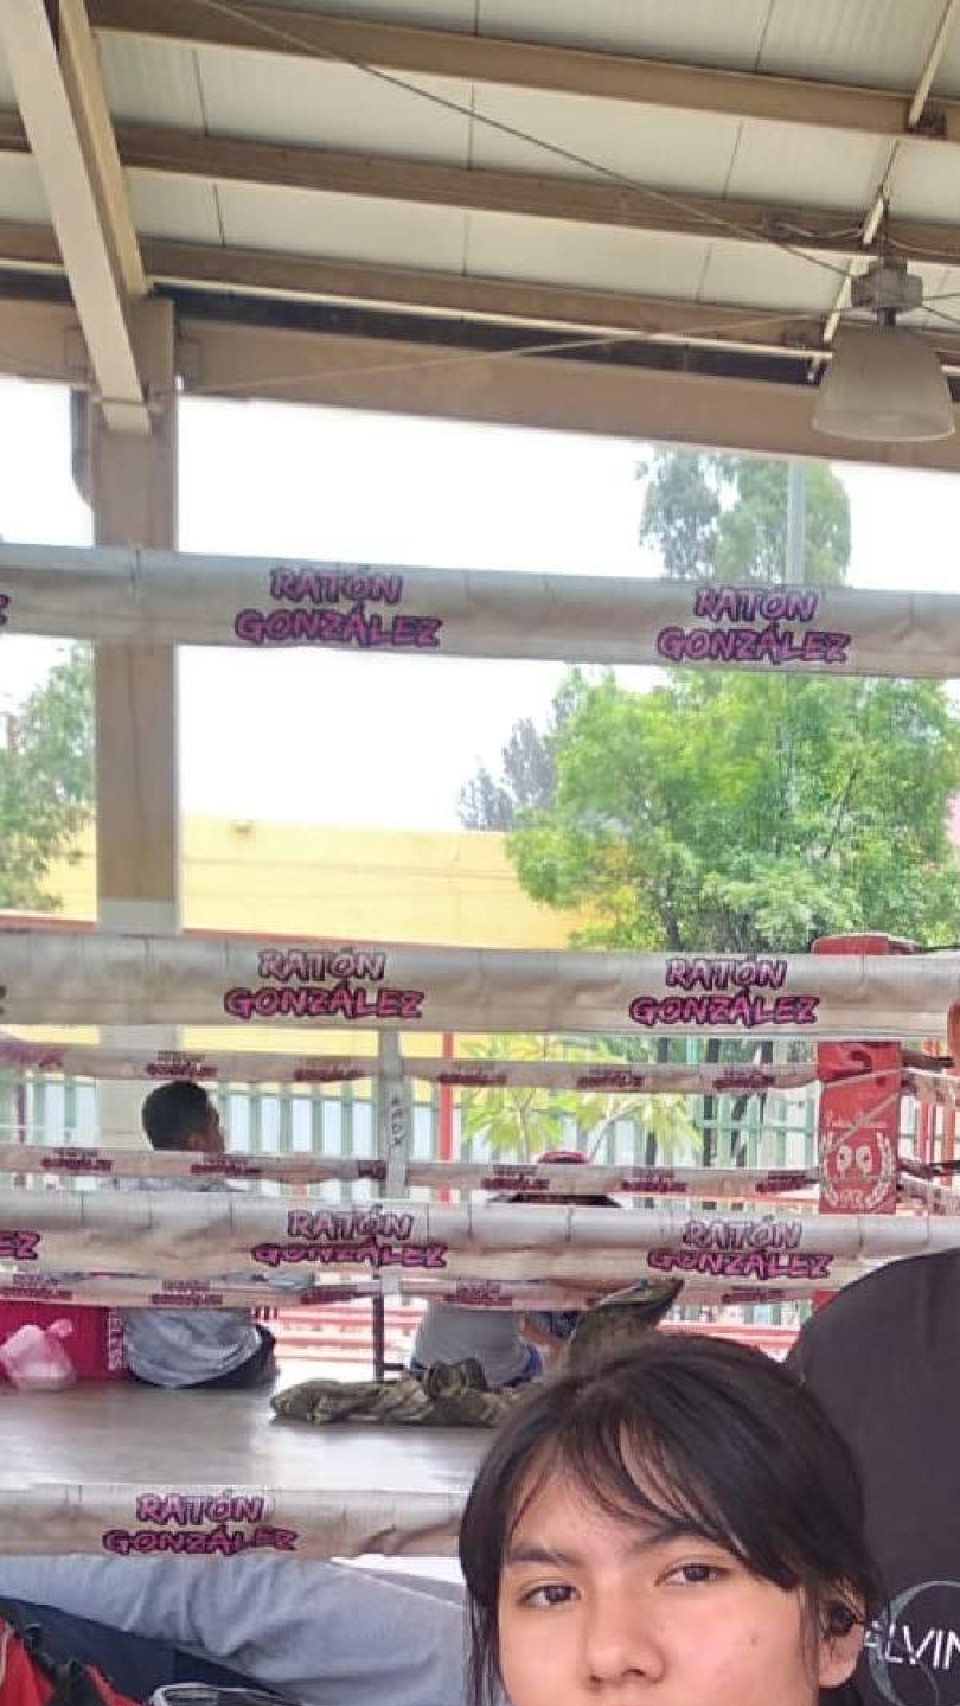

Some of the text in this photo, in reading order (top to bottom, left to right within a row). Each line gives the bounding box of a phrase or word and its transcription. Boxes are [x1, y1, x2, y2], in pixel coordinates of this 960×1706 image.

[234, 603, 442, 648] GONZÁLEZ
[656, 623, 851, 665] GONZÁLEZ
[224, 979, 425, 1019] GONZÁLEZ
[630, 986, 820, 1027] GONZÁLEZ
